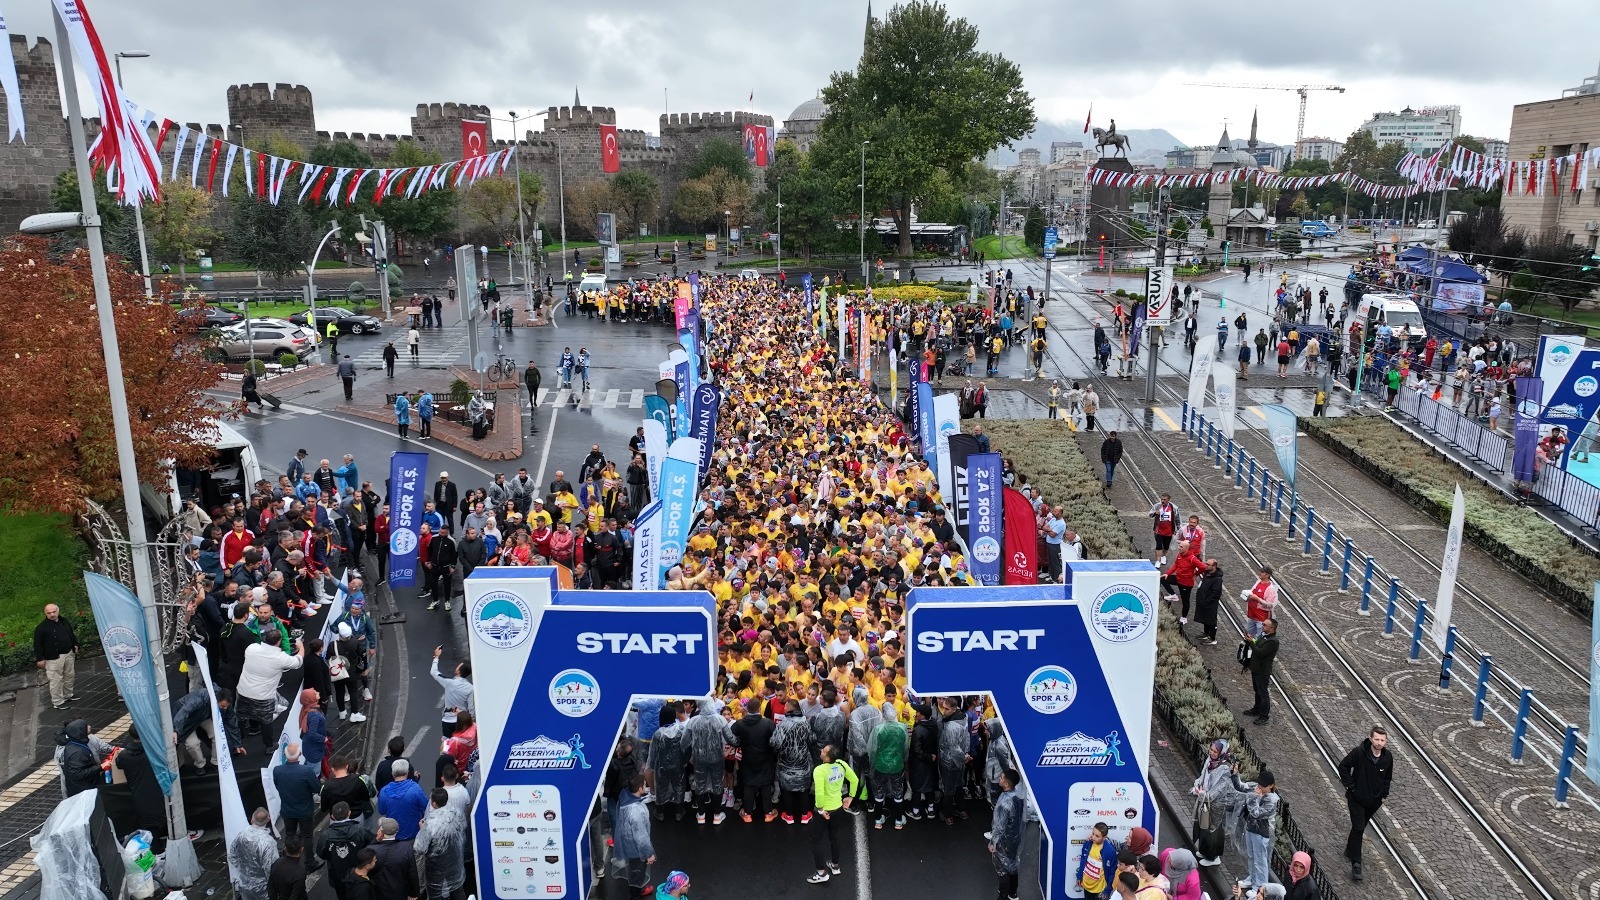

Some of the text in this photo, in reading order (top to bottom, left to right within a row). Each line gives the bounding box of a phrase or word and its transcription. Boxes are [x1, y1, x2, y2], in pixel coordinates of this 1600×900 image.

[1149, 269, 1161, 318] KARUM
[699, 410, 710, 468] DEDEMAN
[400, 468, 419, 527] SPOR A.Ş.
[668, 473, 688, 537] SPOR A.Ş.
[576, 632, 703, 654] START
[917, 629, 1045, 652] START
[508, 759, 573, 769] MARATONU
[1041, 756, 1108, 765] MARATONU
